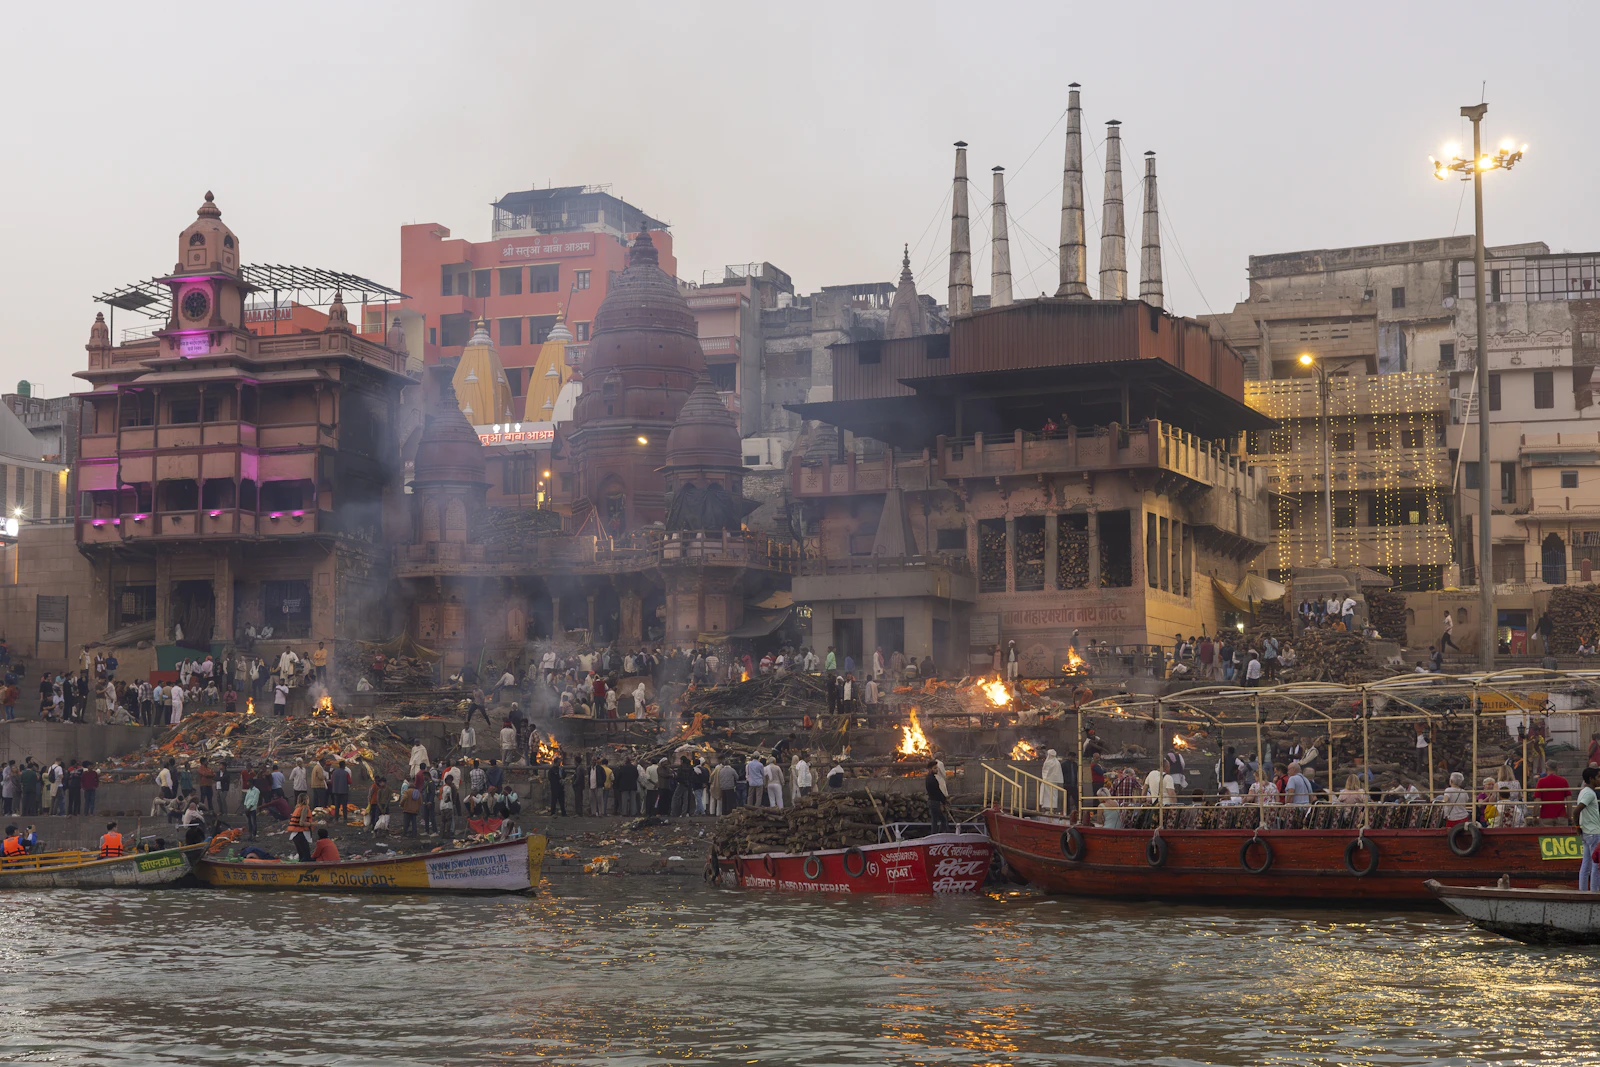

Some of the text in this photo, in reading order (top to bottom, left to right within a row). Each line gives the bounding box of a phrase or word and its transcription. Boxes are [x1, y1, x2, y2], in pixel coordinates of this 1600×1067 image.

[503, 244, 514, 257] श्री
[543, 244, 562, 254] बाबा
[564, 242, 590, 252] आश्रम
[504, 432, 525, 442] बाबा
[526, 430, 554, 440] आश्रम
[1076, 607, 1097, 622] नाथ
[1541, 836, 1578, 856] CNG
[140, 856, 170, 870] सीएनजी
[866, 861, 880, 878] (6)
[296, 873, 320, 884] JSW
